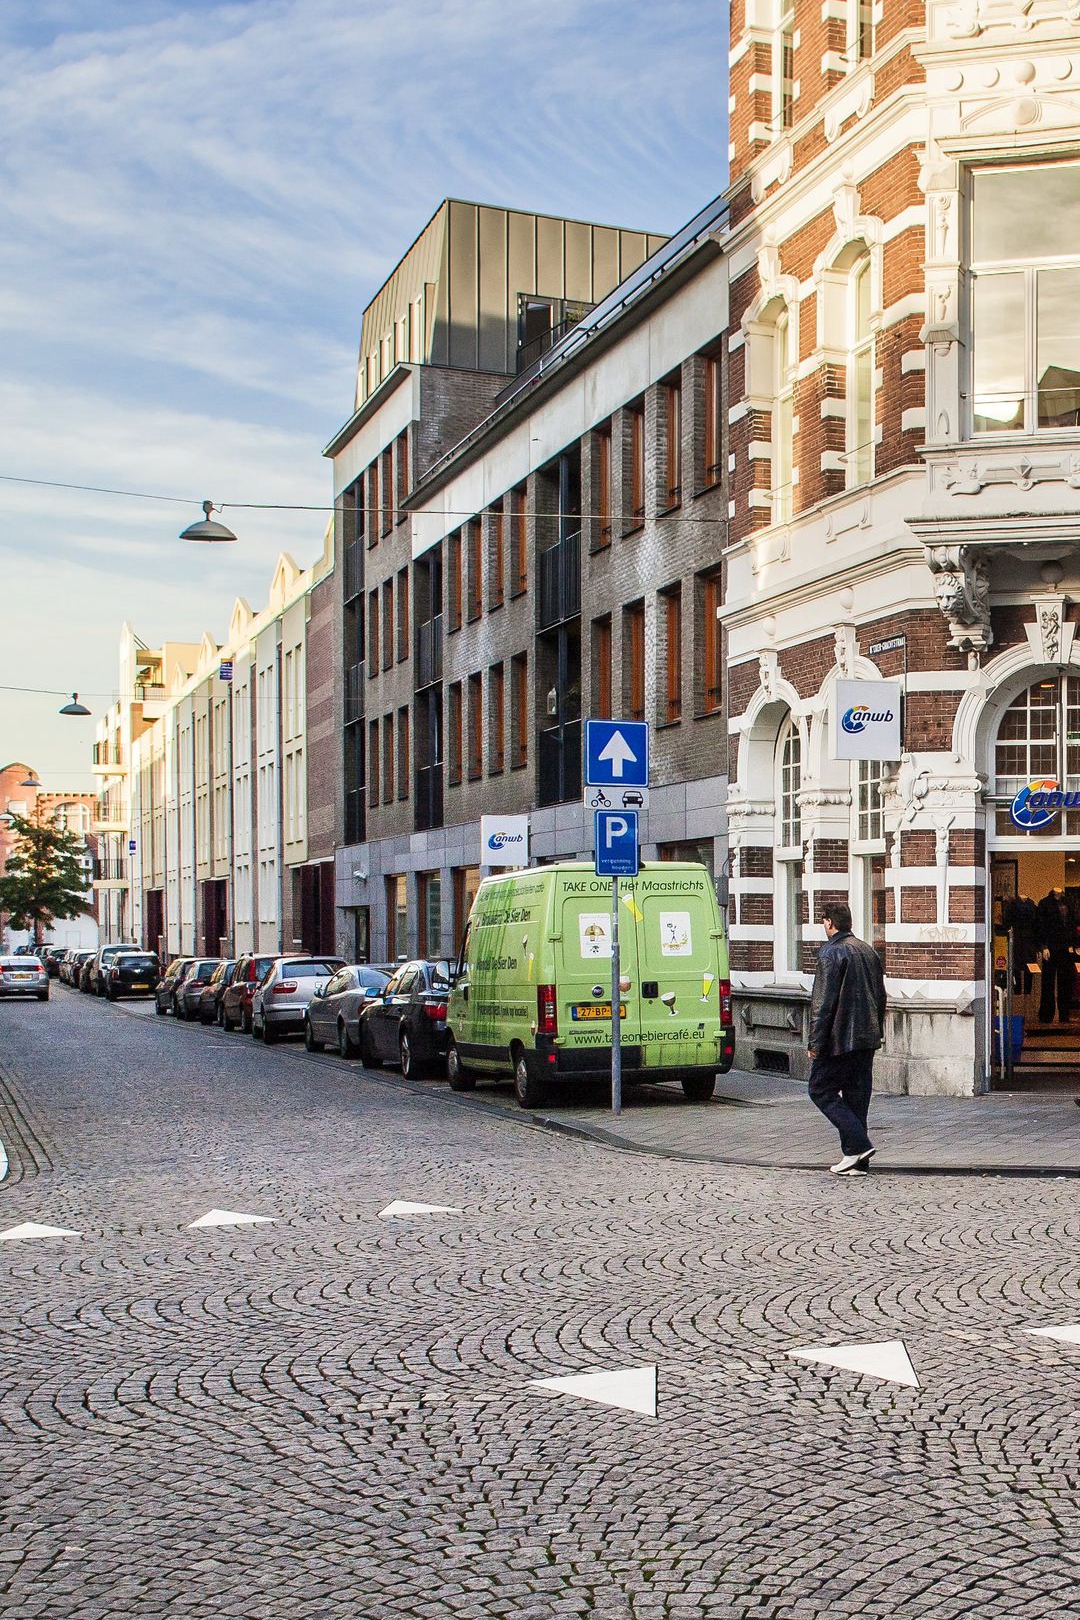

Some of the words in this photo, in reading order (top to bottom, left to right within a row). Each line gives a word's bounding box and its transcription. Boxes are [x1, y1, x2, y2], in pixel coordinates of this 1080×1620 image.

[852, 709, 894, 722] anwb
[606, 816, 628, 848] P
[562, 881, 586, 892] TAKE
[589, 881, 614, 892] ONE
[620, 881, 639, 891] Het
[641, 880, 704, 891] Maastrichts
[574, 1029, 705, 1044] www.taeonebiercafé.eu
